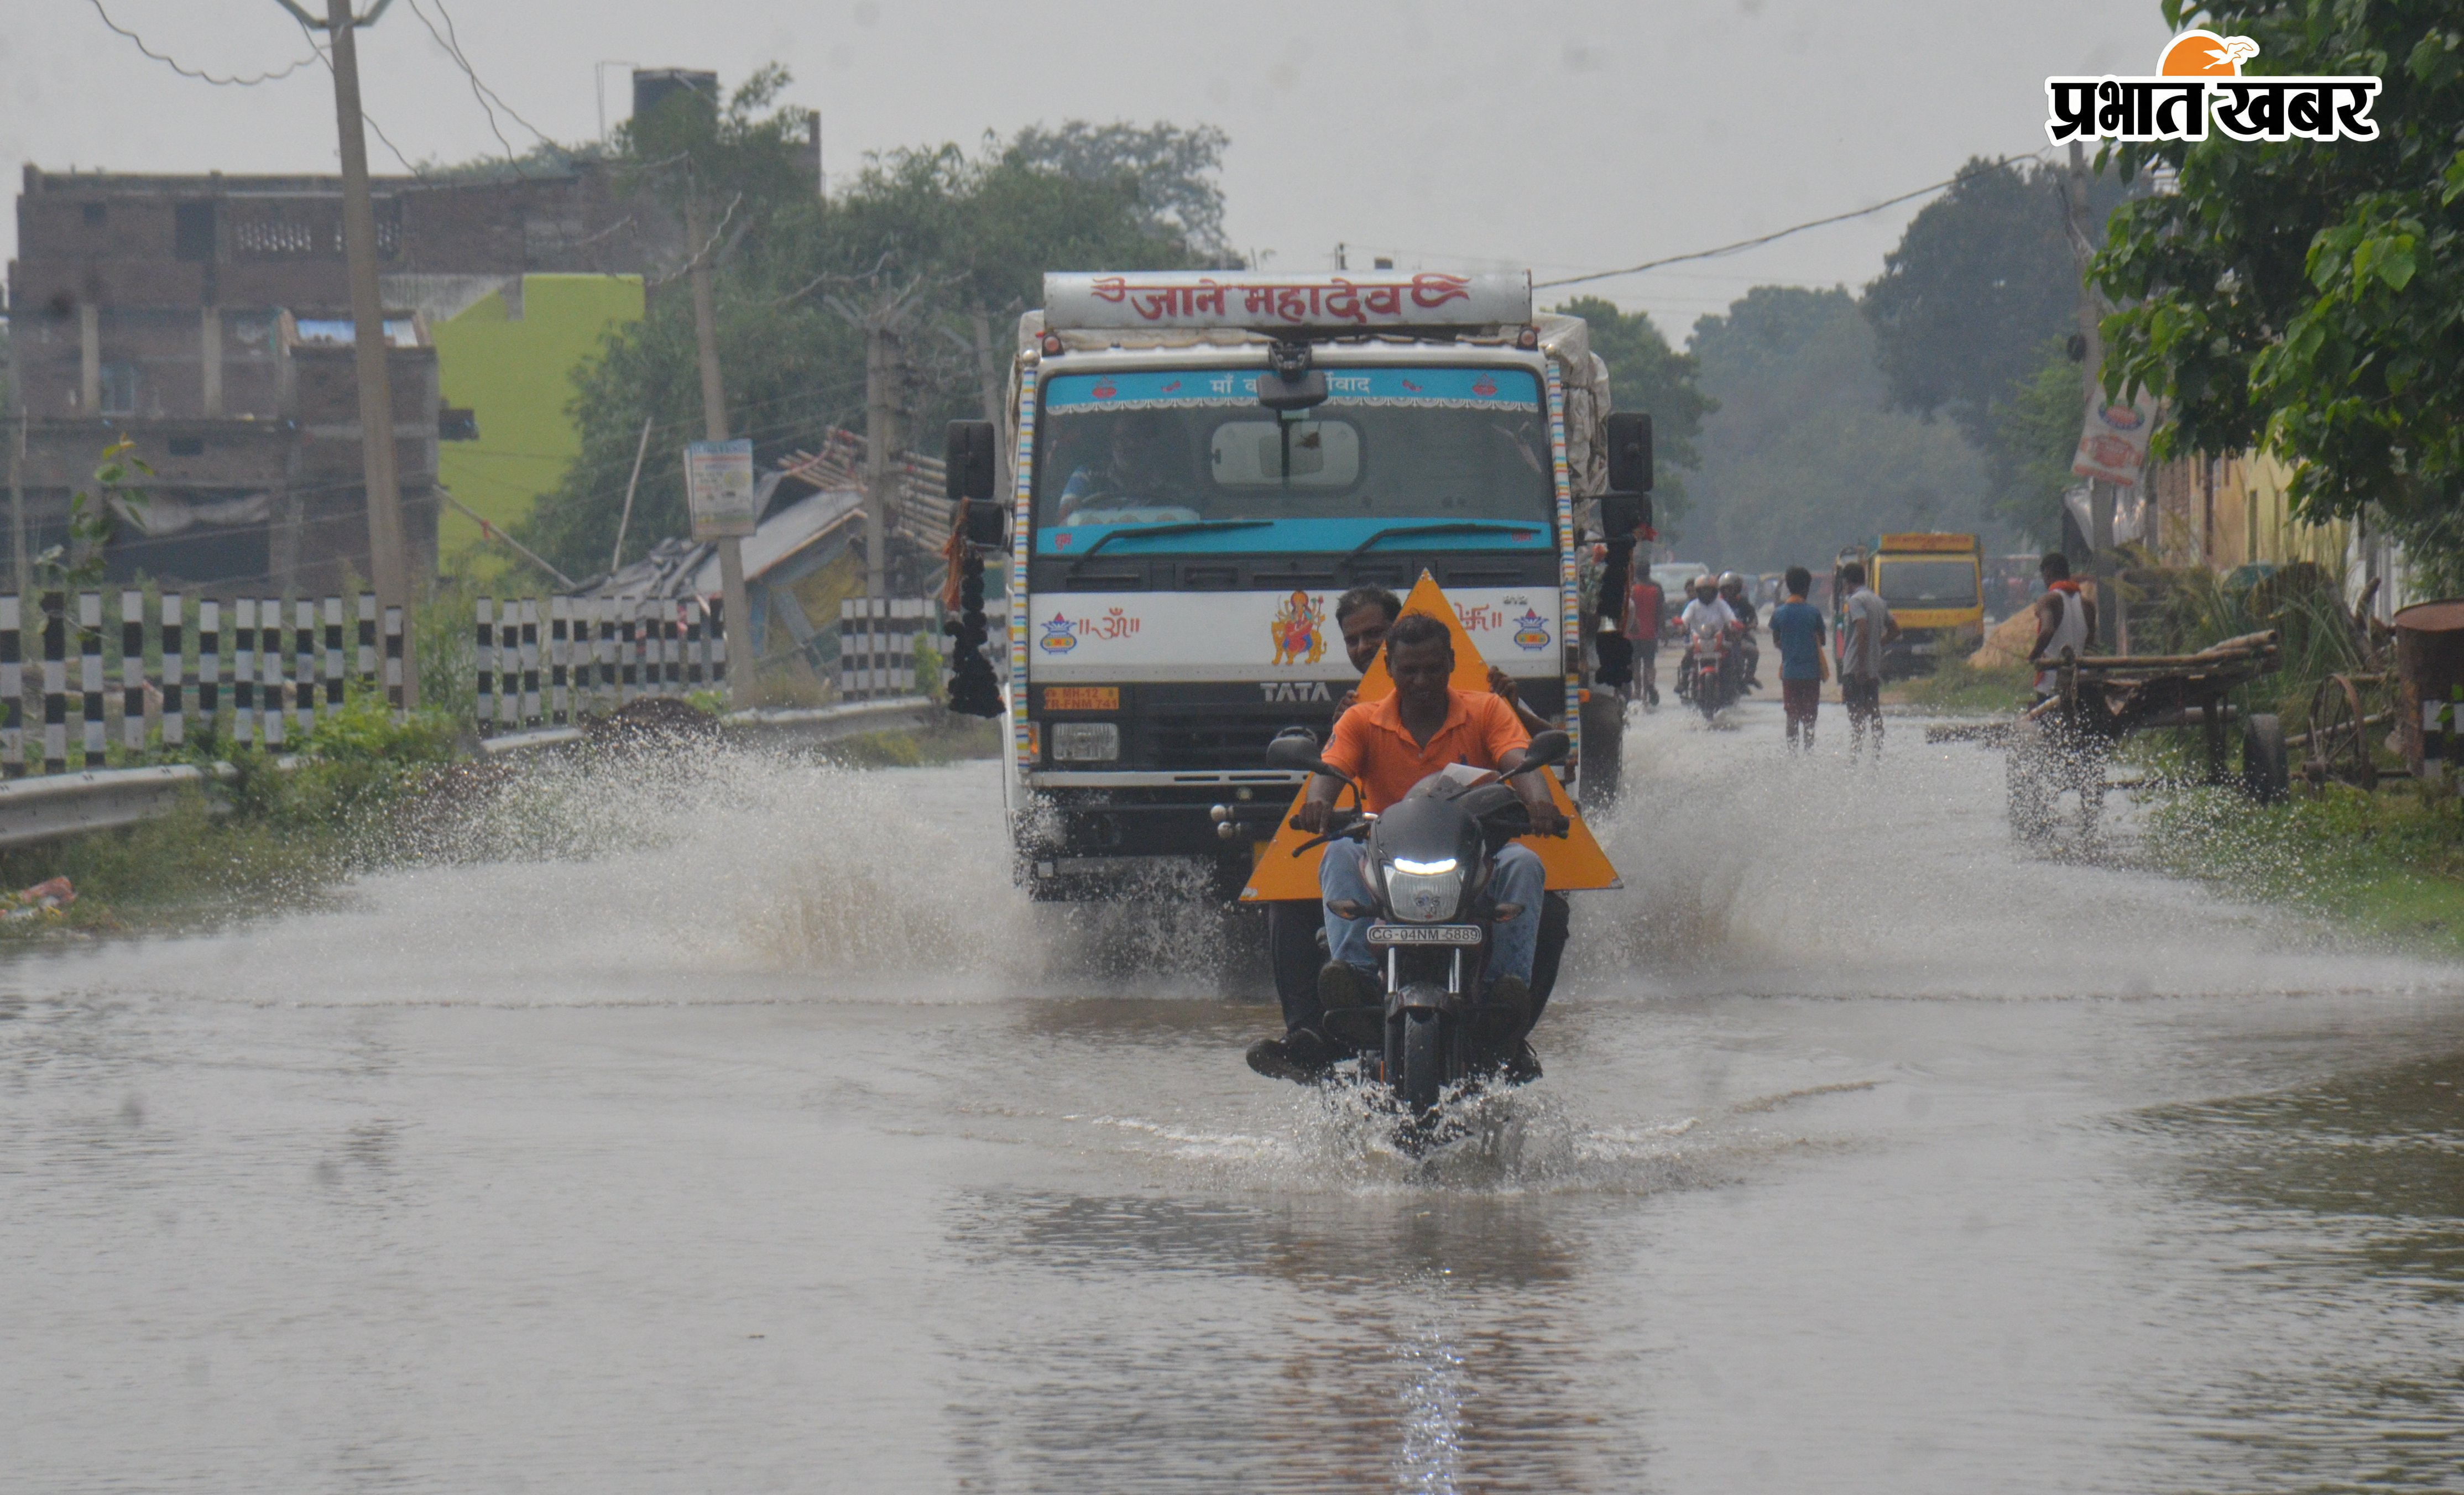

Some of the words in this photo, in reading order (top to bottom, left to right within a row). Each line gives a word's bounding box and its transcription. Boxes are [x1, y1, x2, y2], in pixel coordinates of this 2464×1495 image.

[1131, 278, 1226, 319] जाने
[1243, 277, 1403, 324] महादेव
[1260, 682, 1332, 703] TATA
